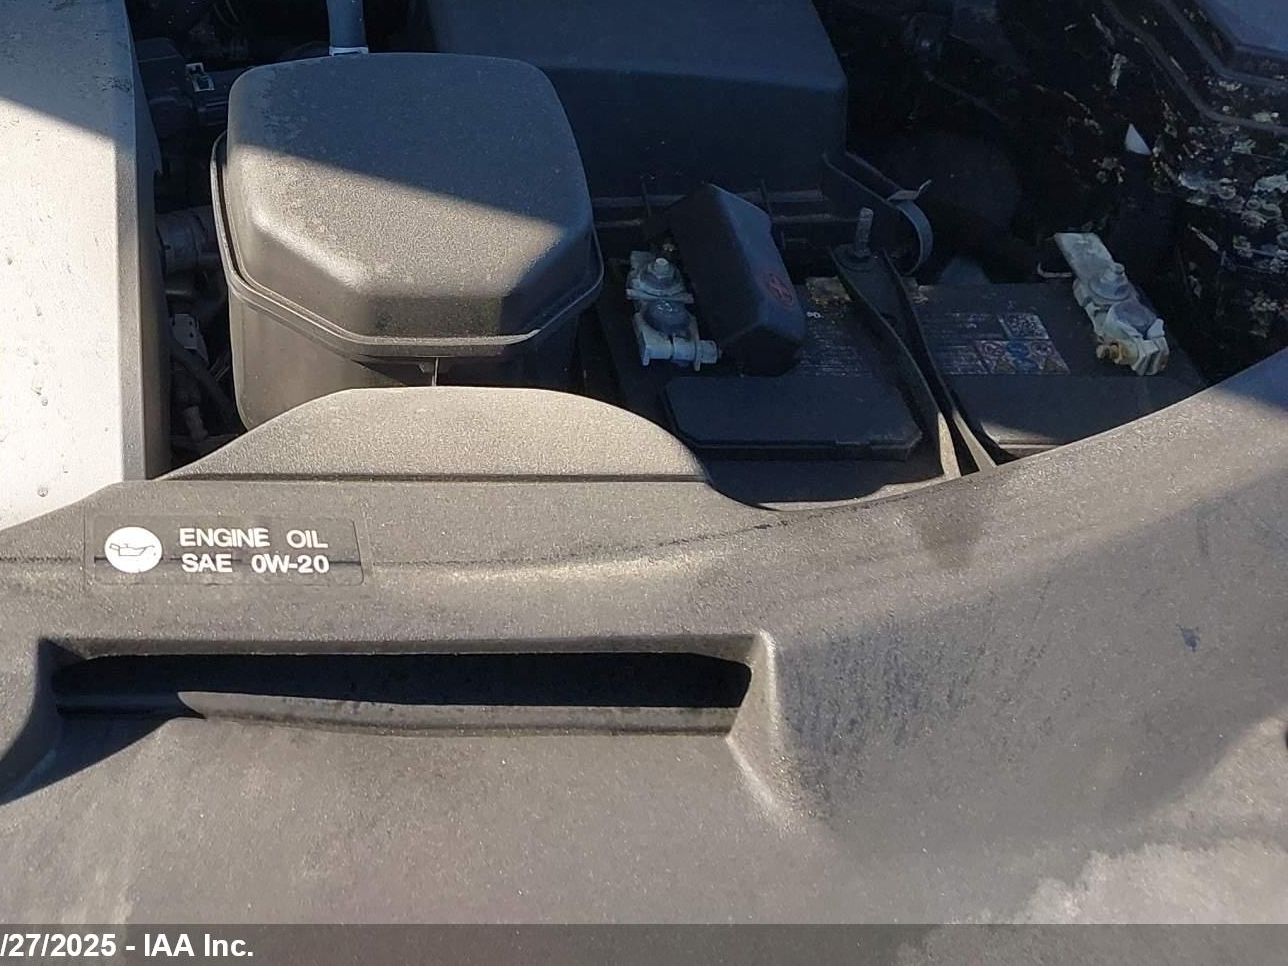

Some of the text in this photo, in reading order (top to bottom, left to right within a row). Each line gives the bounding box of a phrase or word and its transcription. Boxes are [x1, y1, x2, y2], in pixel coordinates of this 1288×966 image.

[179, 527, 329, 549] ENGINE OIL
[181, 553, 330, 574] SAE 0W-20
